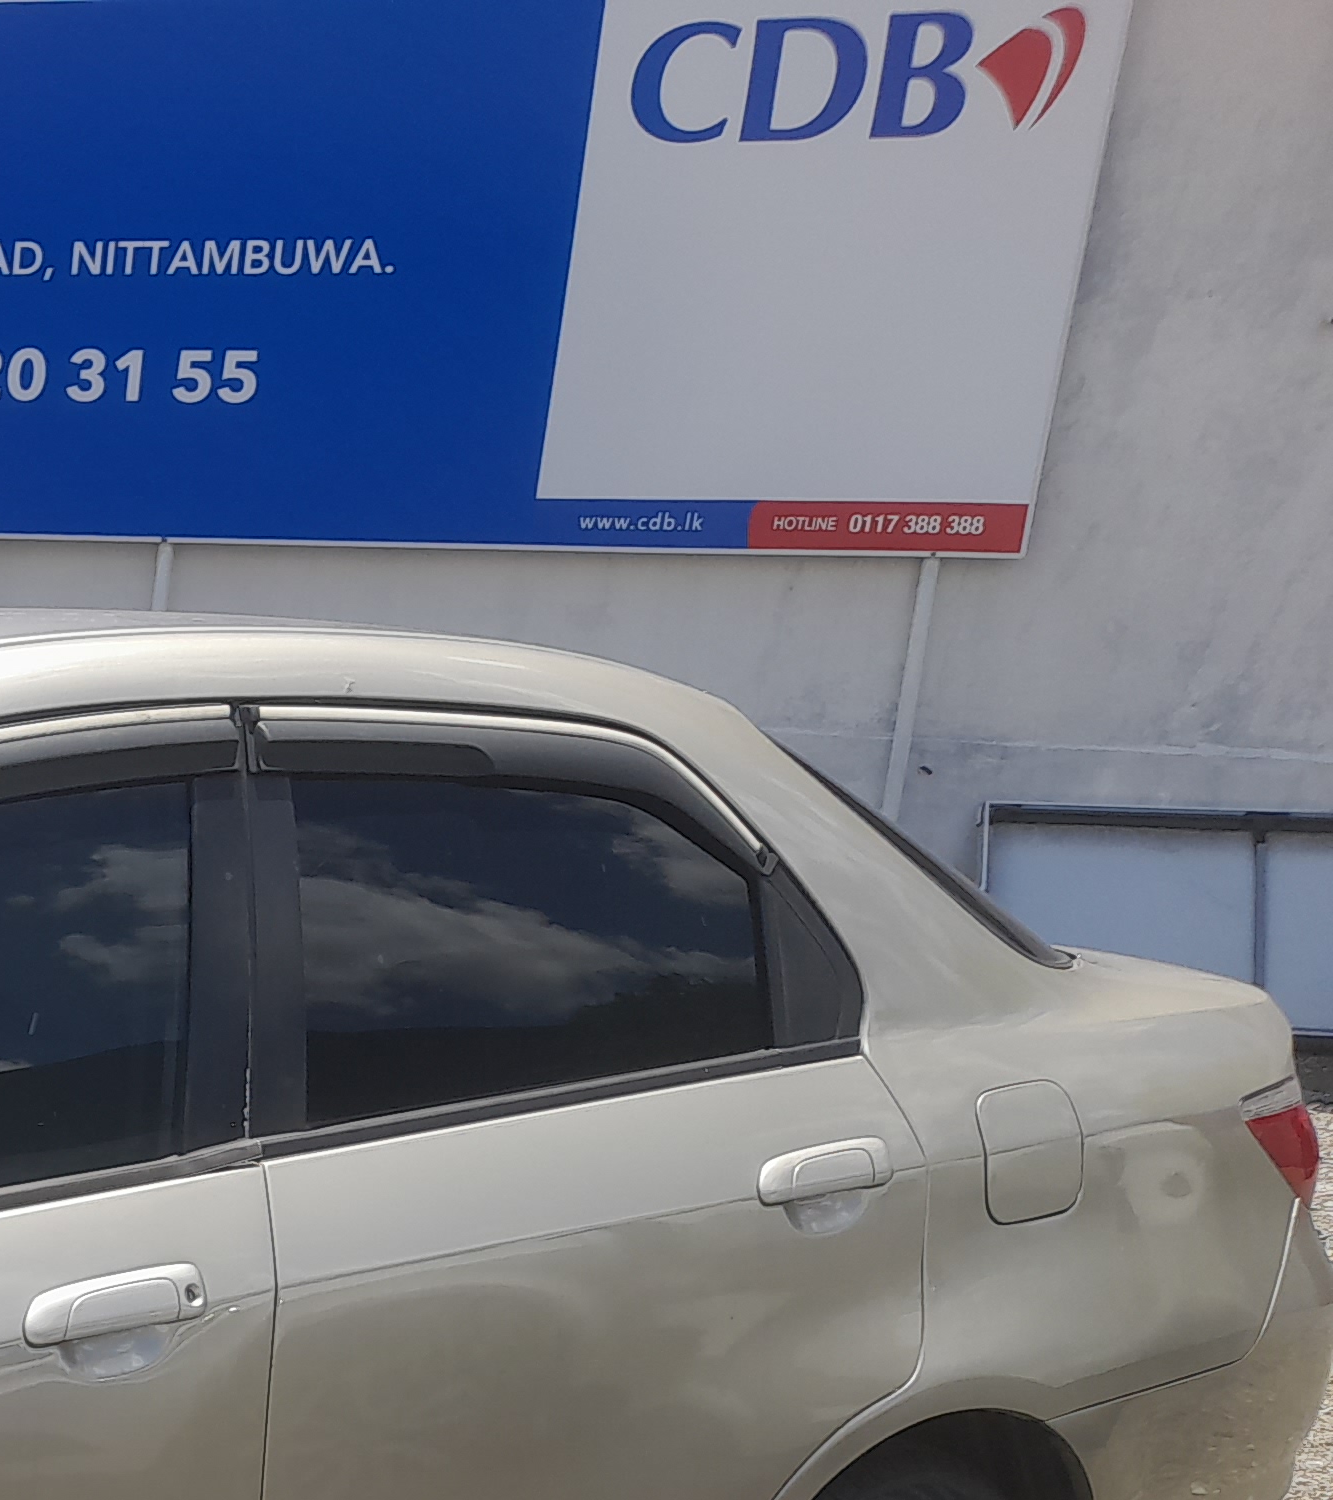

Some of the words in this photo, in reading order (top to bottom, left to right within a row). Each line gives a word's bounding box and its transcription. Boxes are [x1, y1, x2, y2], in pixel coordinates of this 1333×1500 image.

[630, 11, 974, 144] CDB
[71, 238, 394, 275] NITTAMBUWA.
[65, 348, 144, 403] 31
[172, 349, 258, 404] 55
[579, 511, 704, 531] www.cdb.lk
[772, 516, 837, 531] HOTLINE
[848, 514, 900, 533] 0117
[903, 514, 942, 534] 388
[945, 515, 985, 535] 388
